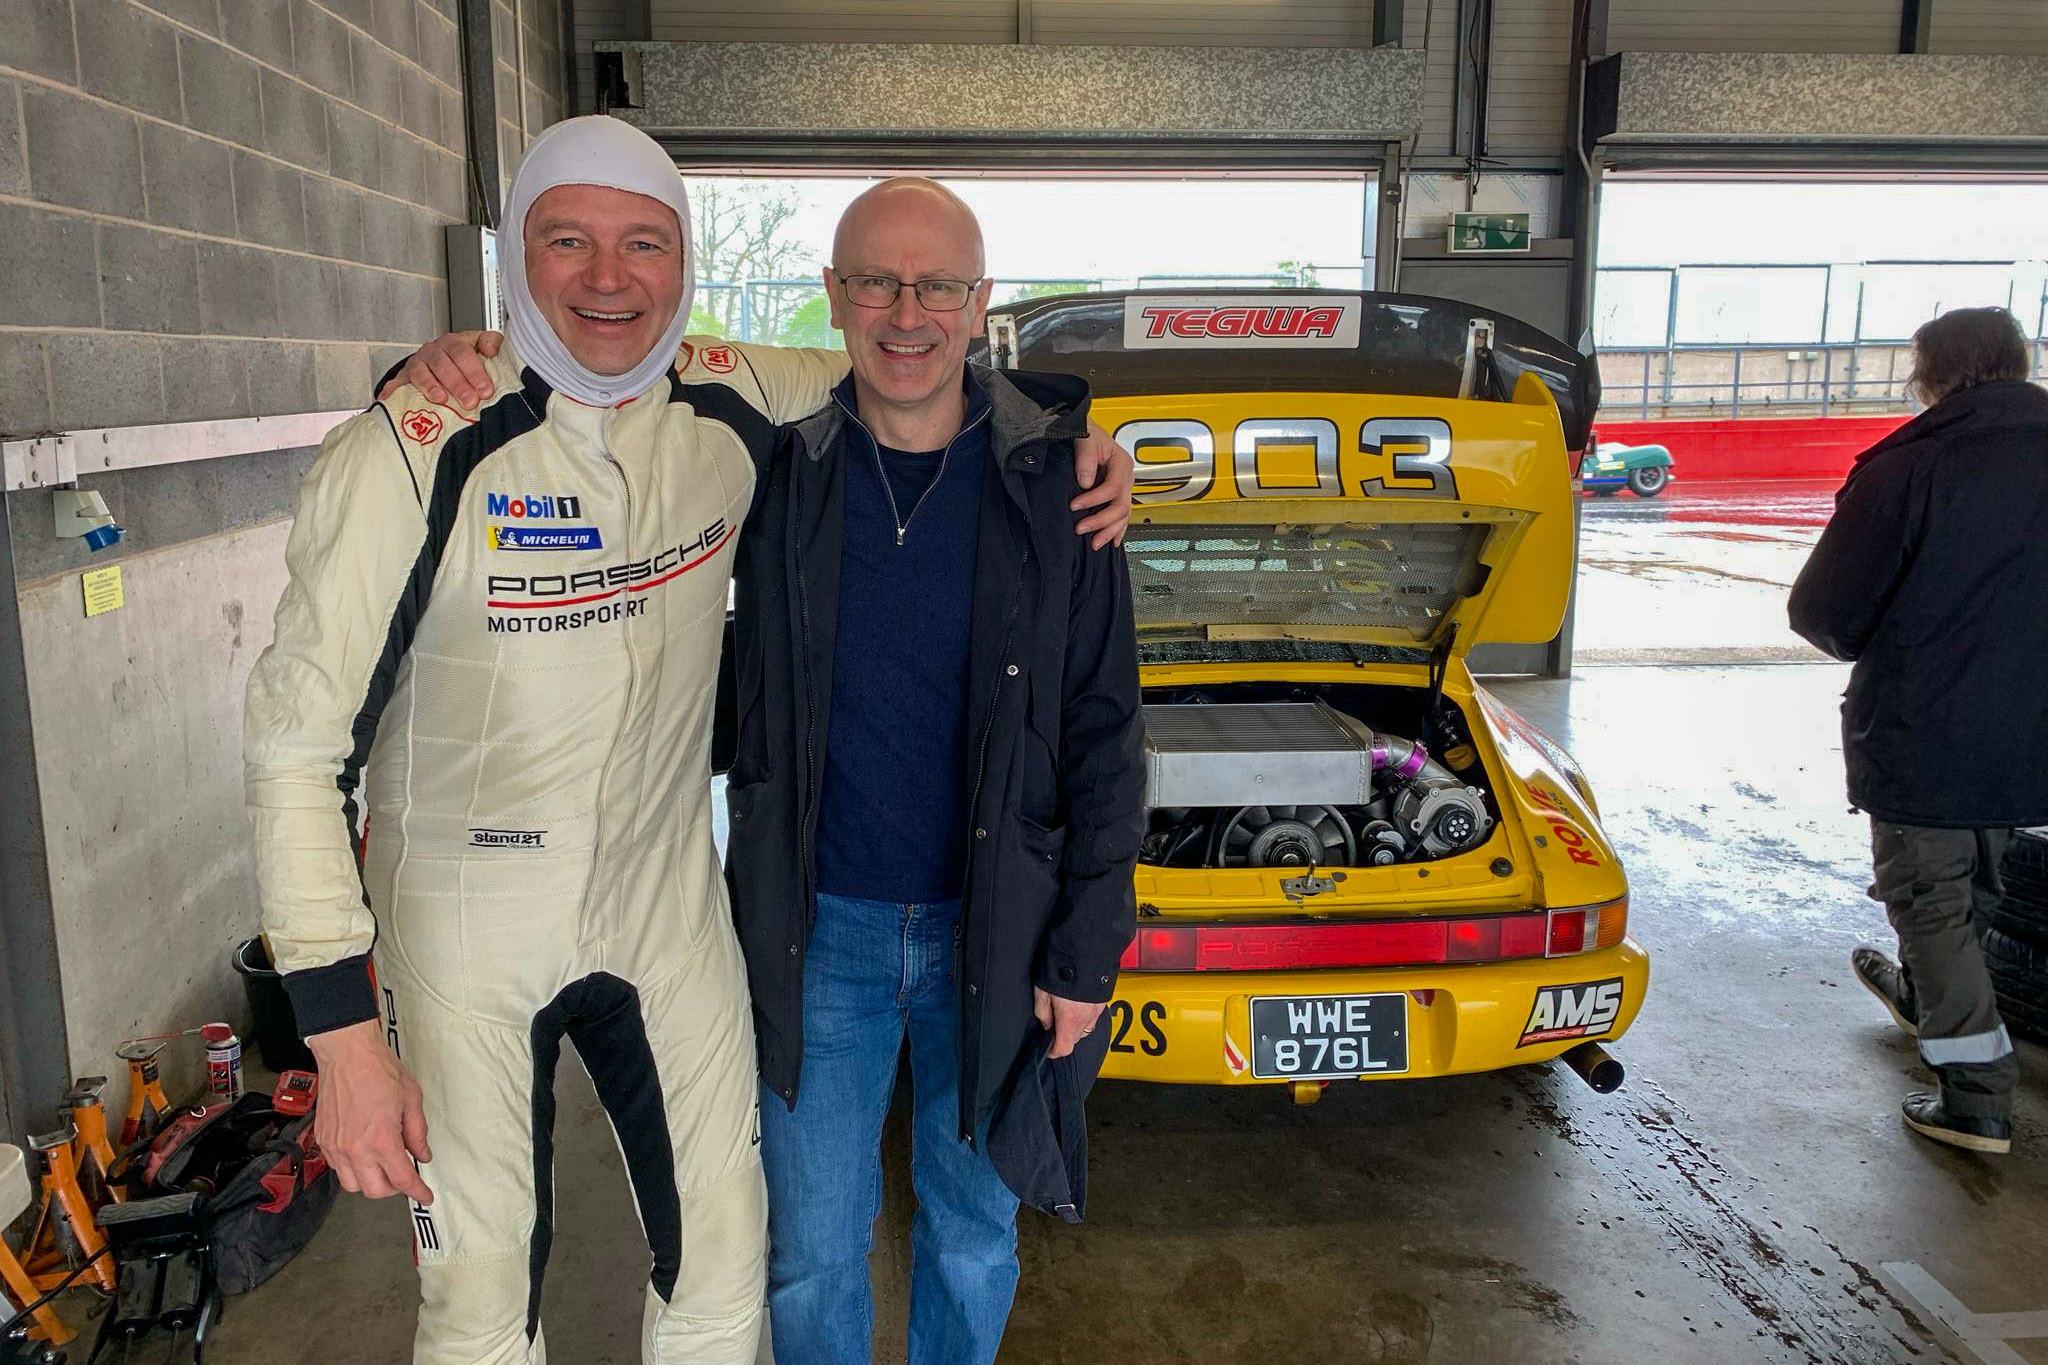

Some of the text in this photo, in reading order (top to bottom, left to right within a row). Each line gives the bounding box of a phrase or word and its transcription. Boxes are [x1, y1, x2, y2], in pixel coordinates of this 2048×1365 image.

[1141, 306, 1345, 338] TEGIWA
[1114, 417, 1460, 504] 903
[487, 492, 555, 519] Mobil
[488, 517, 726, 596] PORSCHE
[521, 534, 590, 545] MICHELIN
[1287, 1000, 1372, 1035] WWE
[1524, 982, 1622, 1034] AMS
[1109, 1000, 1168, 1056] 2S
[1275, 1037, 1388, 1072] 876L
